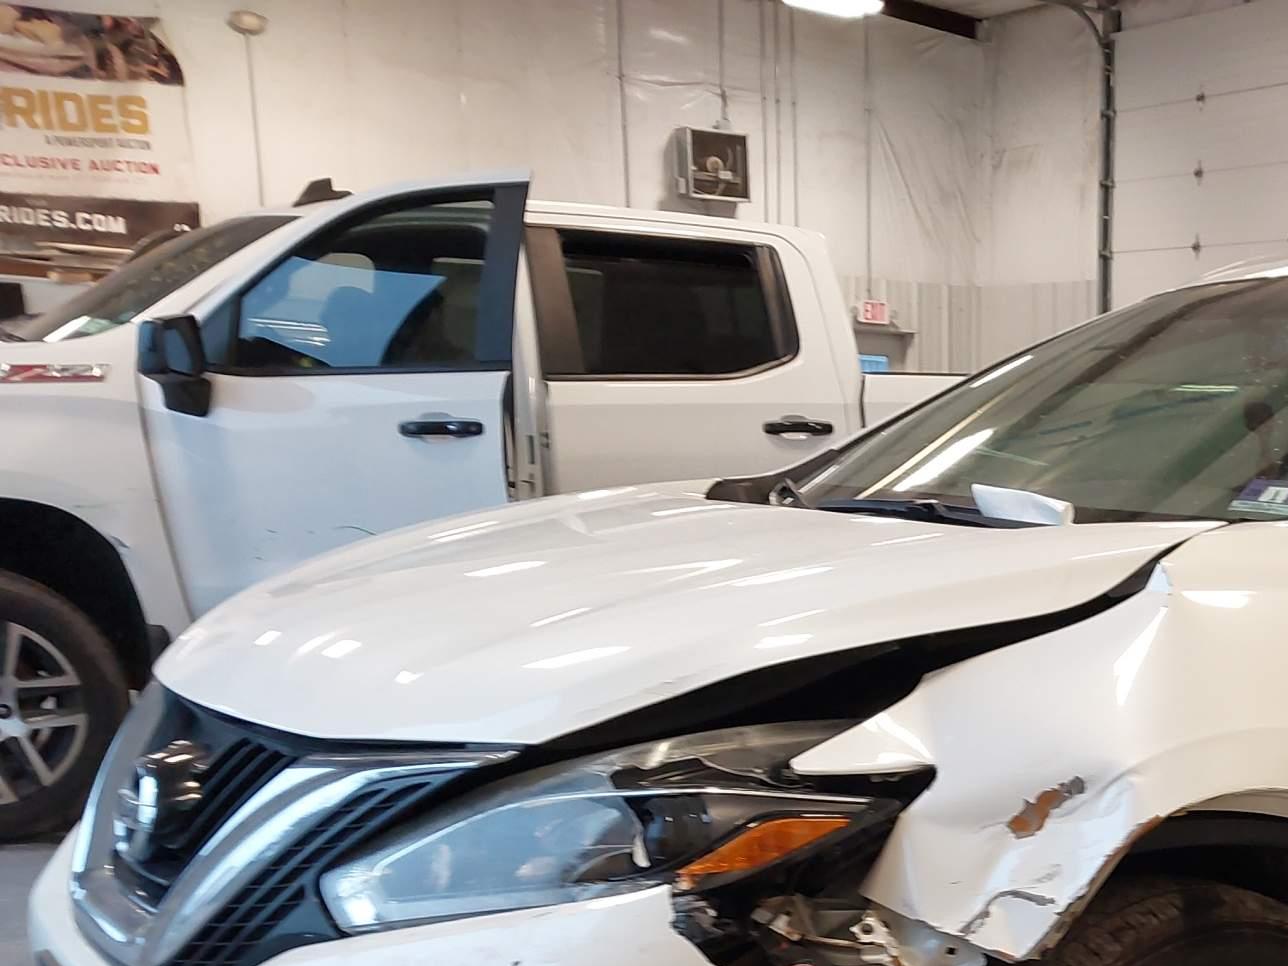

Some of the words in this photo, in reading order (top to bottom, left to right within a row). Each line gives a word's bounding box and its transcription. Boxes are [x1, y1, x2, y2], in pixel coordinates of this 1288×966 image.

[0, 87, 151, 134] RIDES
[88, 159, 161, 175] AUCTION
[0, 205, 127, 234] RIDES.COM
